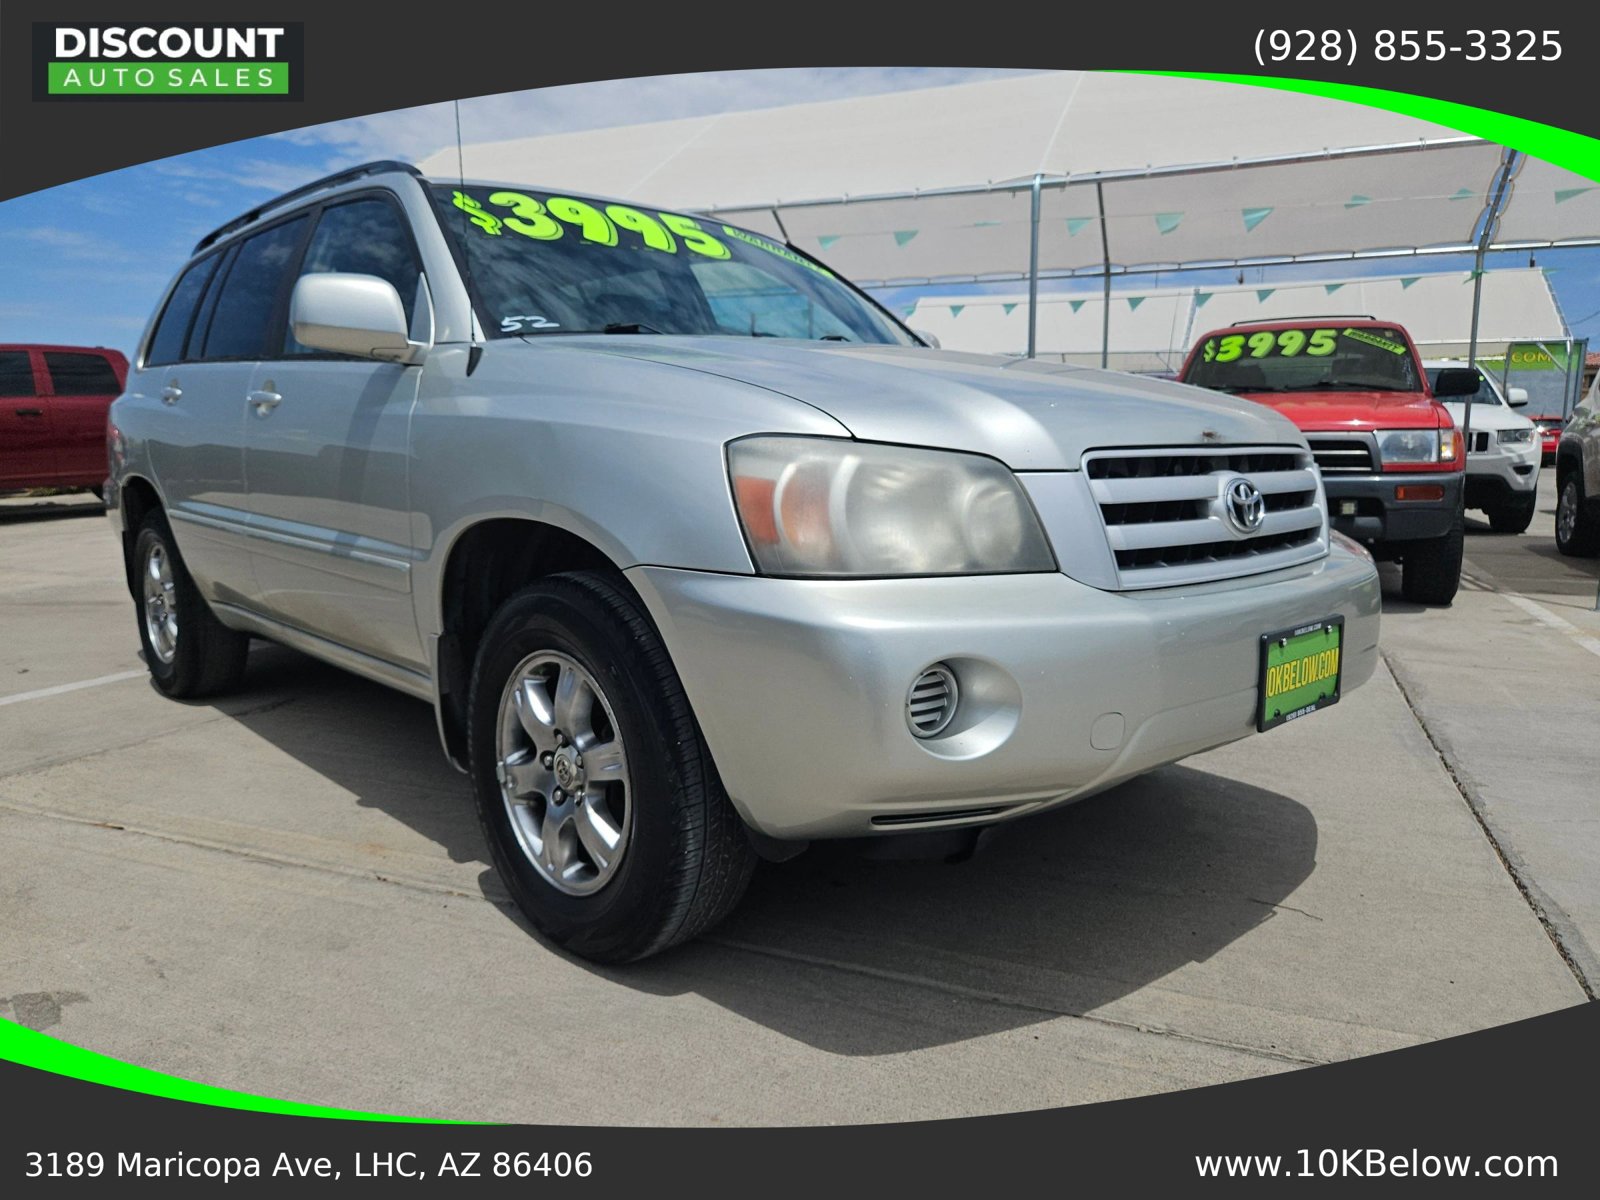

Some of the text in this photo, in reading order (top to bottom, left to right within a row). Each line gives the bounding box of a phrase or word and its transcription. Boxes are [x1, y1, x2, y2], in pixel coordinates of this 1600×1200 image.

[452, 190, 732, 260] $3995
[501, 315, 560, 332] 52
[1203, 328, 1338, 363] $3995
